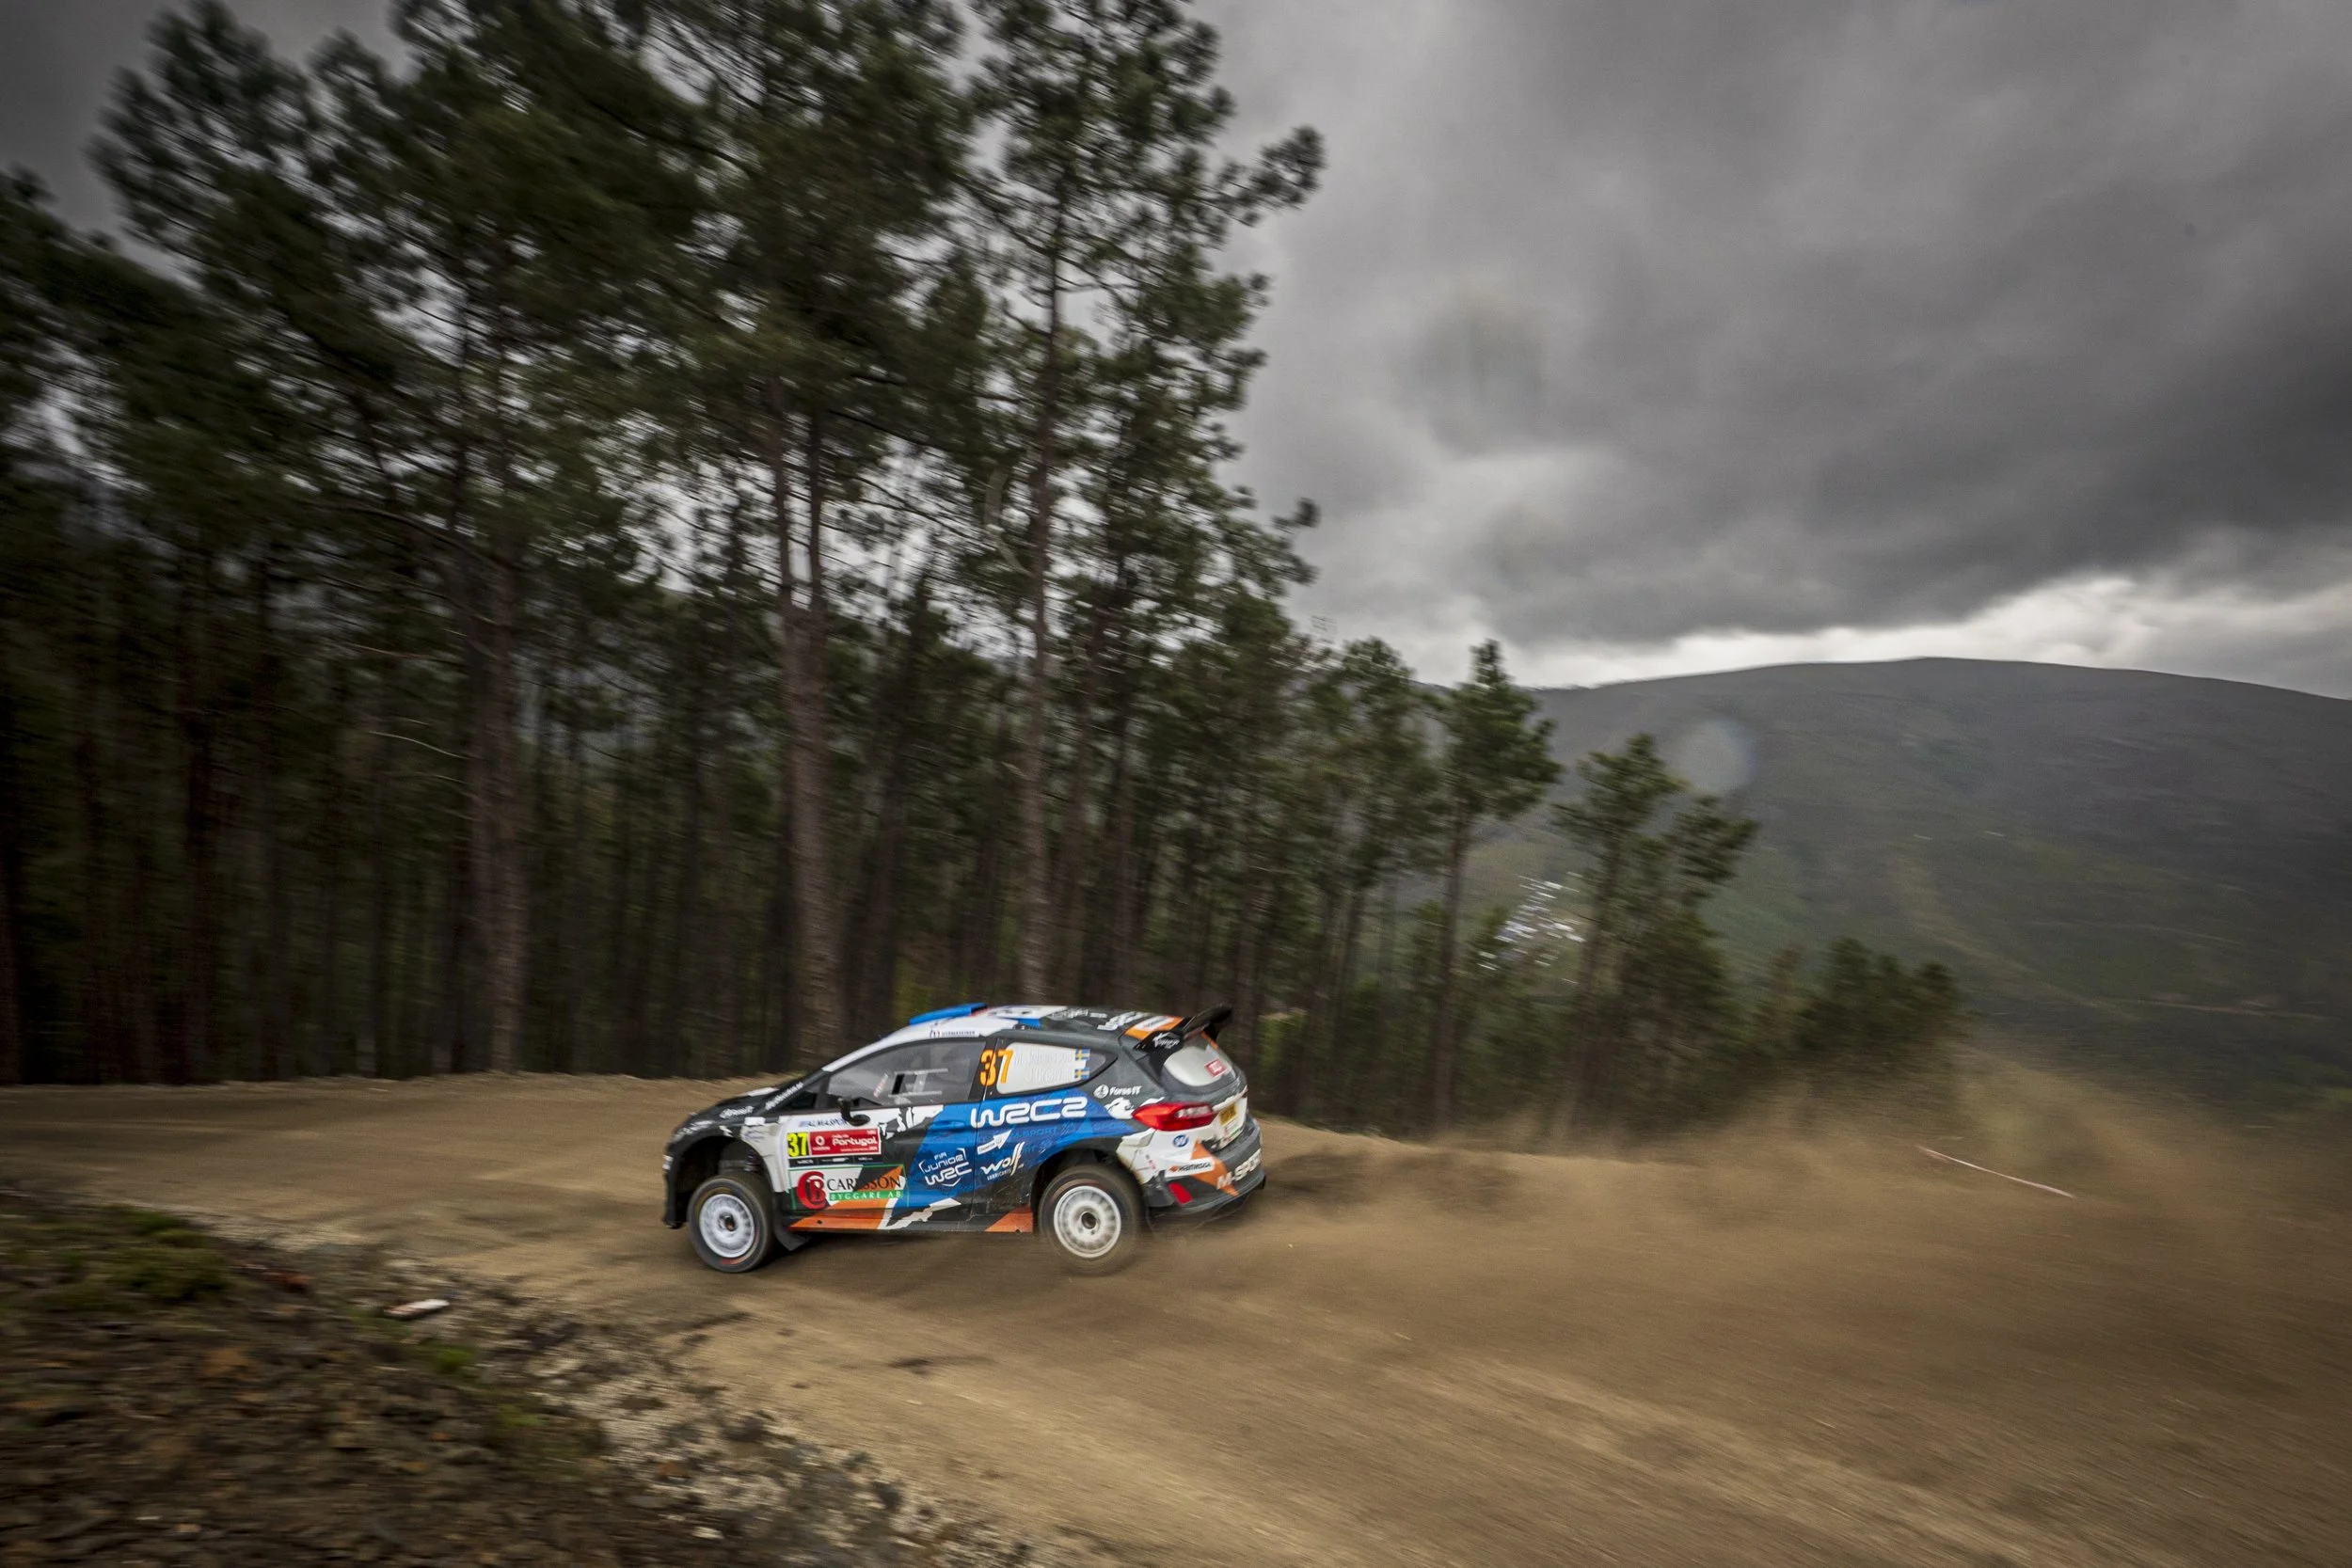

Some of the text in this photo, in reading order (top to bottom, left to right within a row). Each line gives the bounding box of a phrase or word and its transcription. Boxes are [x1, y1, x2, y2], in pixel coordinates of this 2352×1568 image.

[979, 1049, 1014, 1086] 37
[970, 1096, 1088, 1129] WRC2
[787, 1132, 809, 1158] 37
[832, 1135, 878, 1147] Portugal
[827, 1175, 901, 1192] CARSON
[925, 1161, 973, 1185] WRC
[887, 1190, 902, 1199] AB
